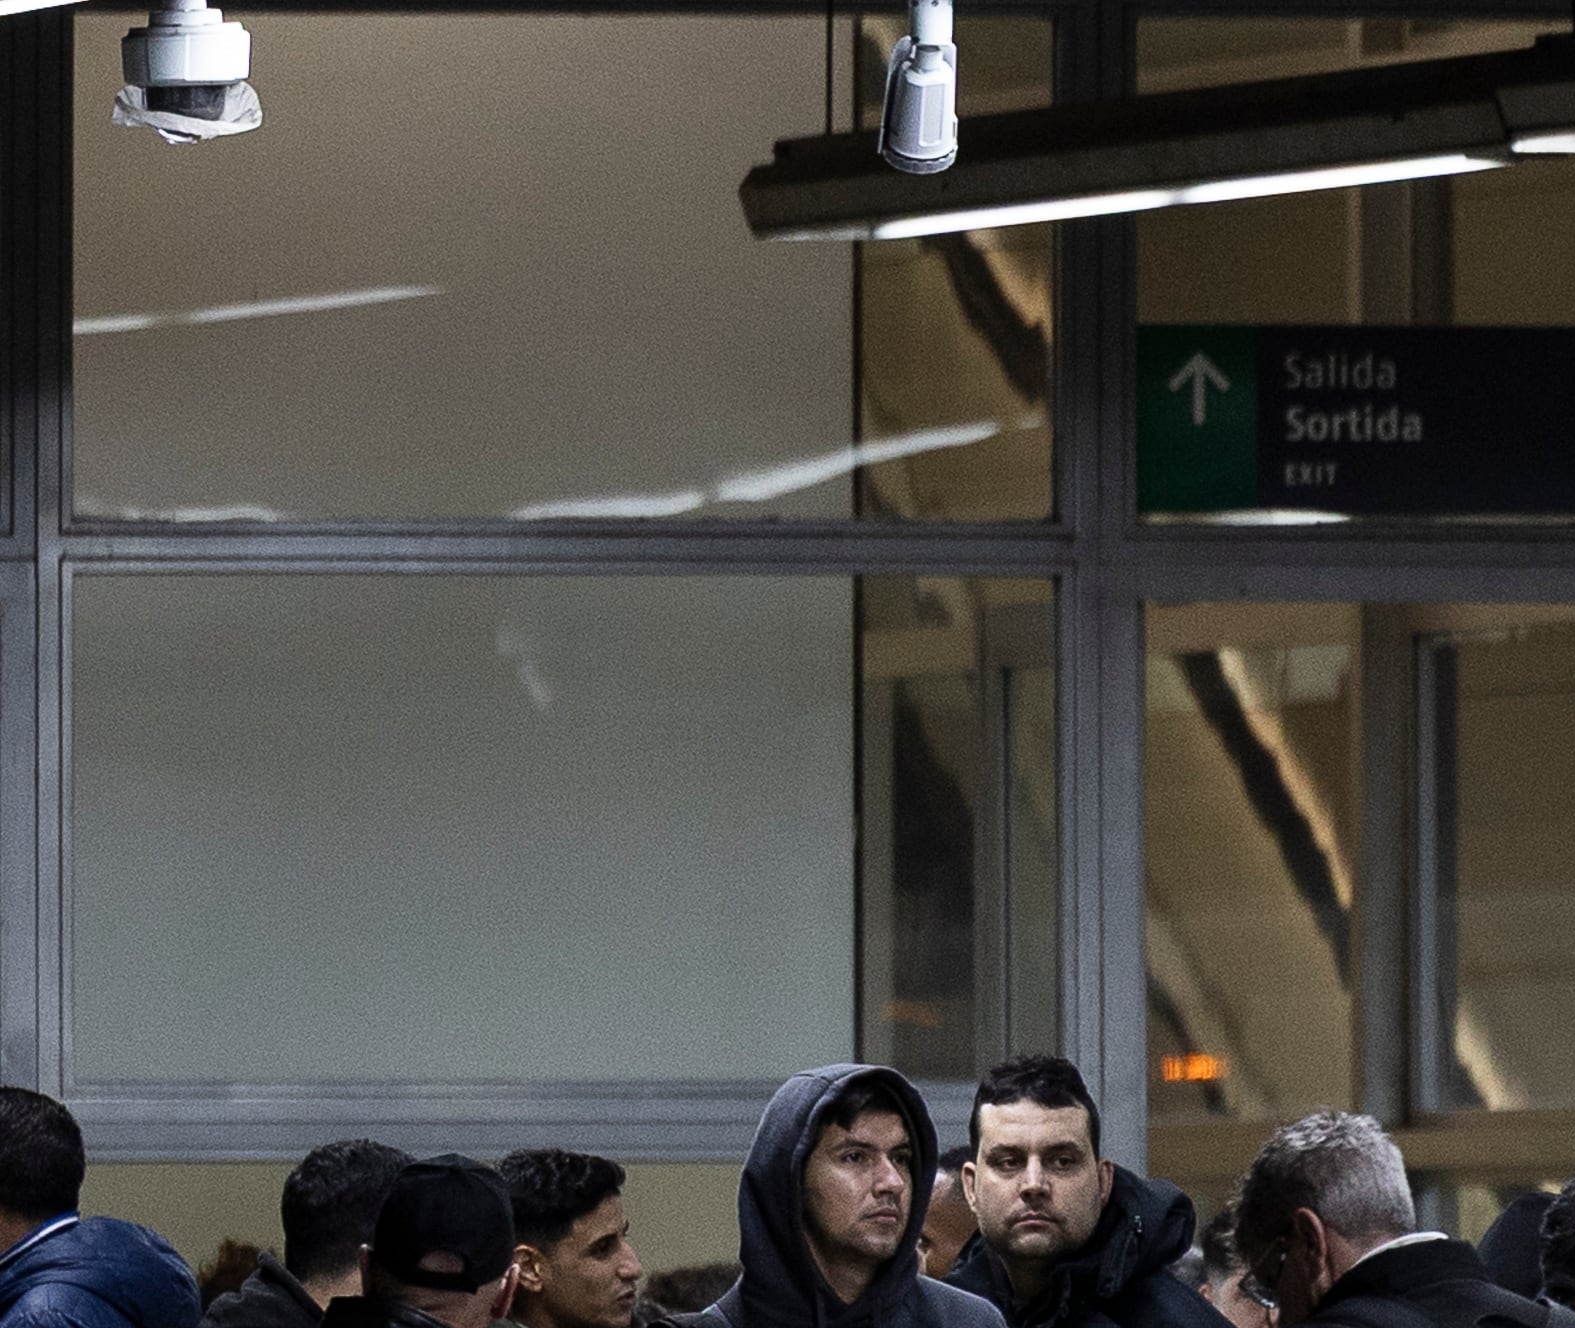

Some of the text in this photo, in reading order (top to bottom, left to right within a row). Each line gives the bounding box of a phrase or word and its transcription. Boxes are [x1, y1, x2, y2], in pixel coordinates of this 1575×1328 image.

[1284, 353, 1397, 390] Salida
[1285, 405, 1423, 442] Sortida
[1285, 462, 1337, 487] EXIT
